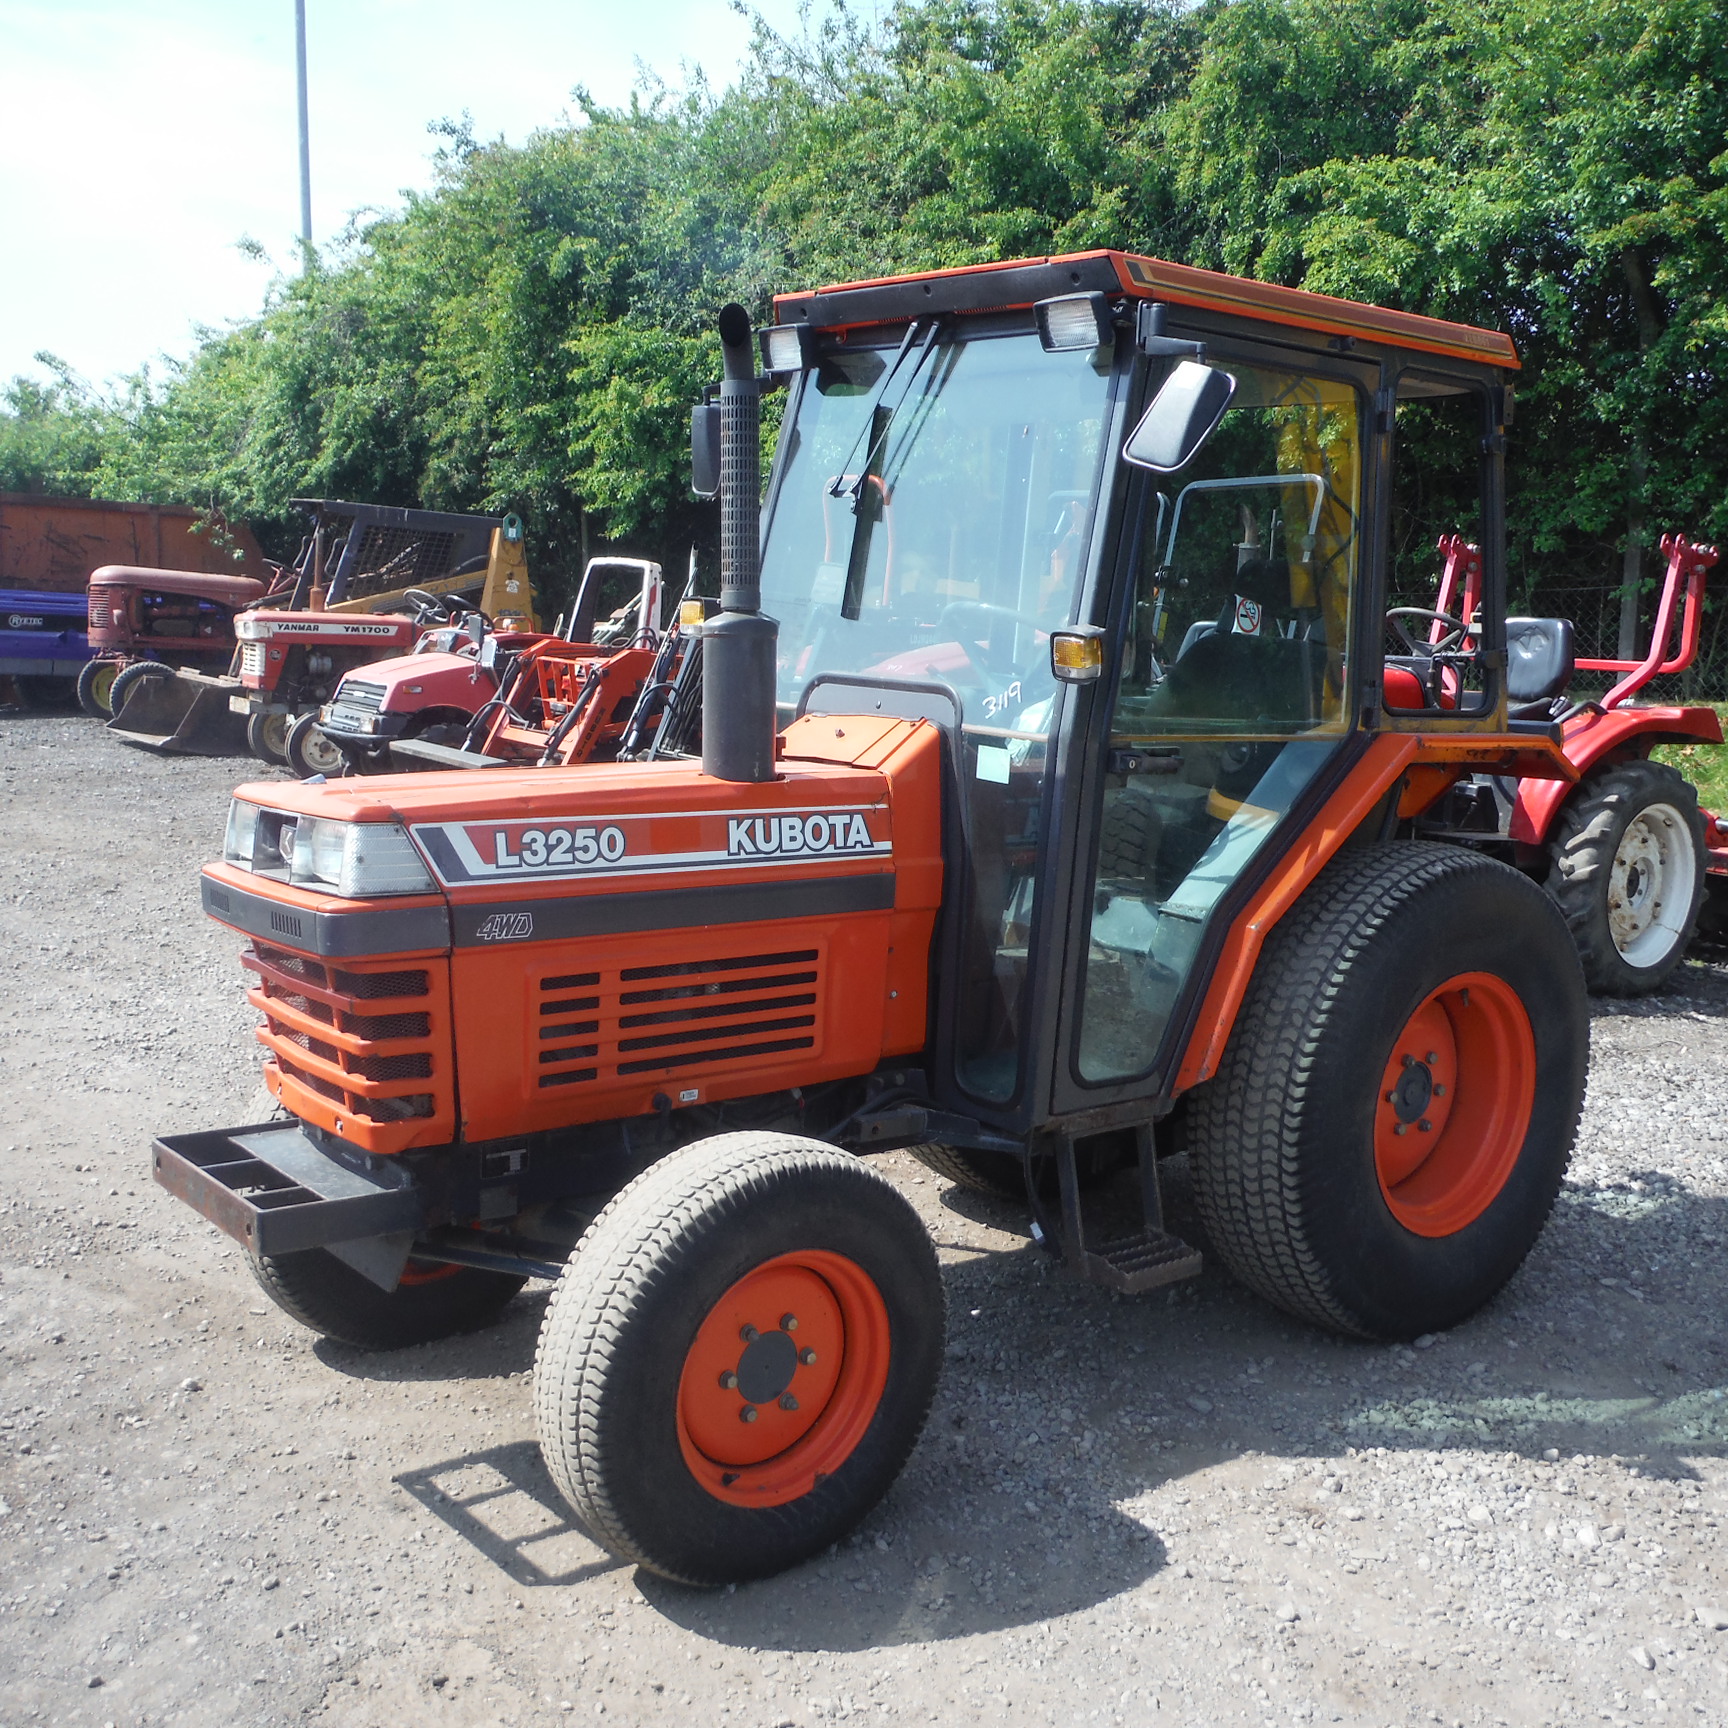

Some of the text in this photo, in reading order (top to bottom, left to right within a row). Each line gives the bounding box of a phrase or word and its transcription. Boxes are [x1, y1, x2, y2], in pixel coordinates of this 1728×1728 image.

[277, 623, 390, 634] YANMAR YM1700
[982, 680, 1022, 719] 3119
[494, 812, 874, 869] L3250 KUBOTA
[476, 912, 533, 940] 4WD
